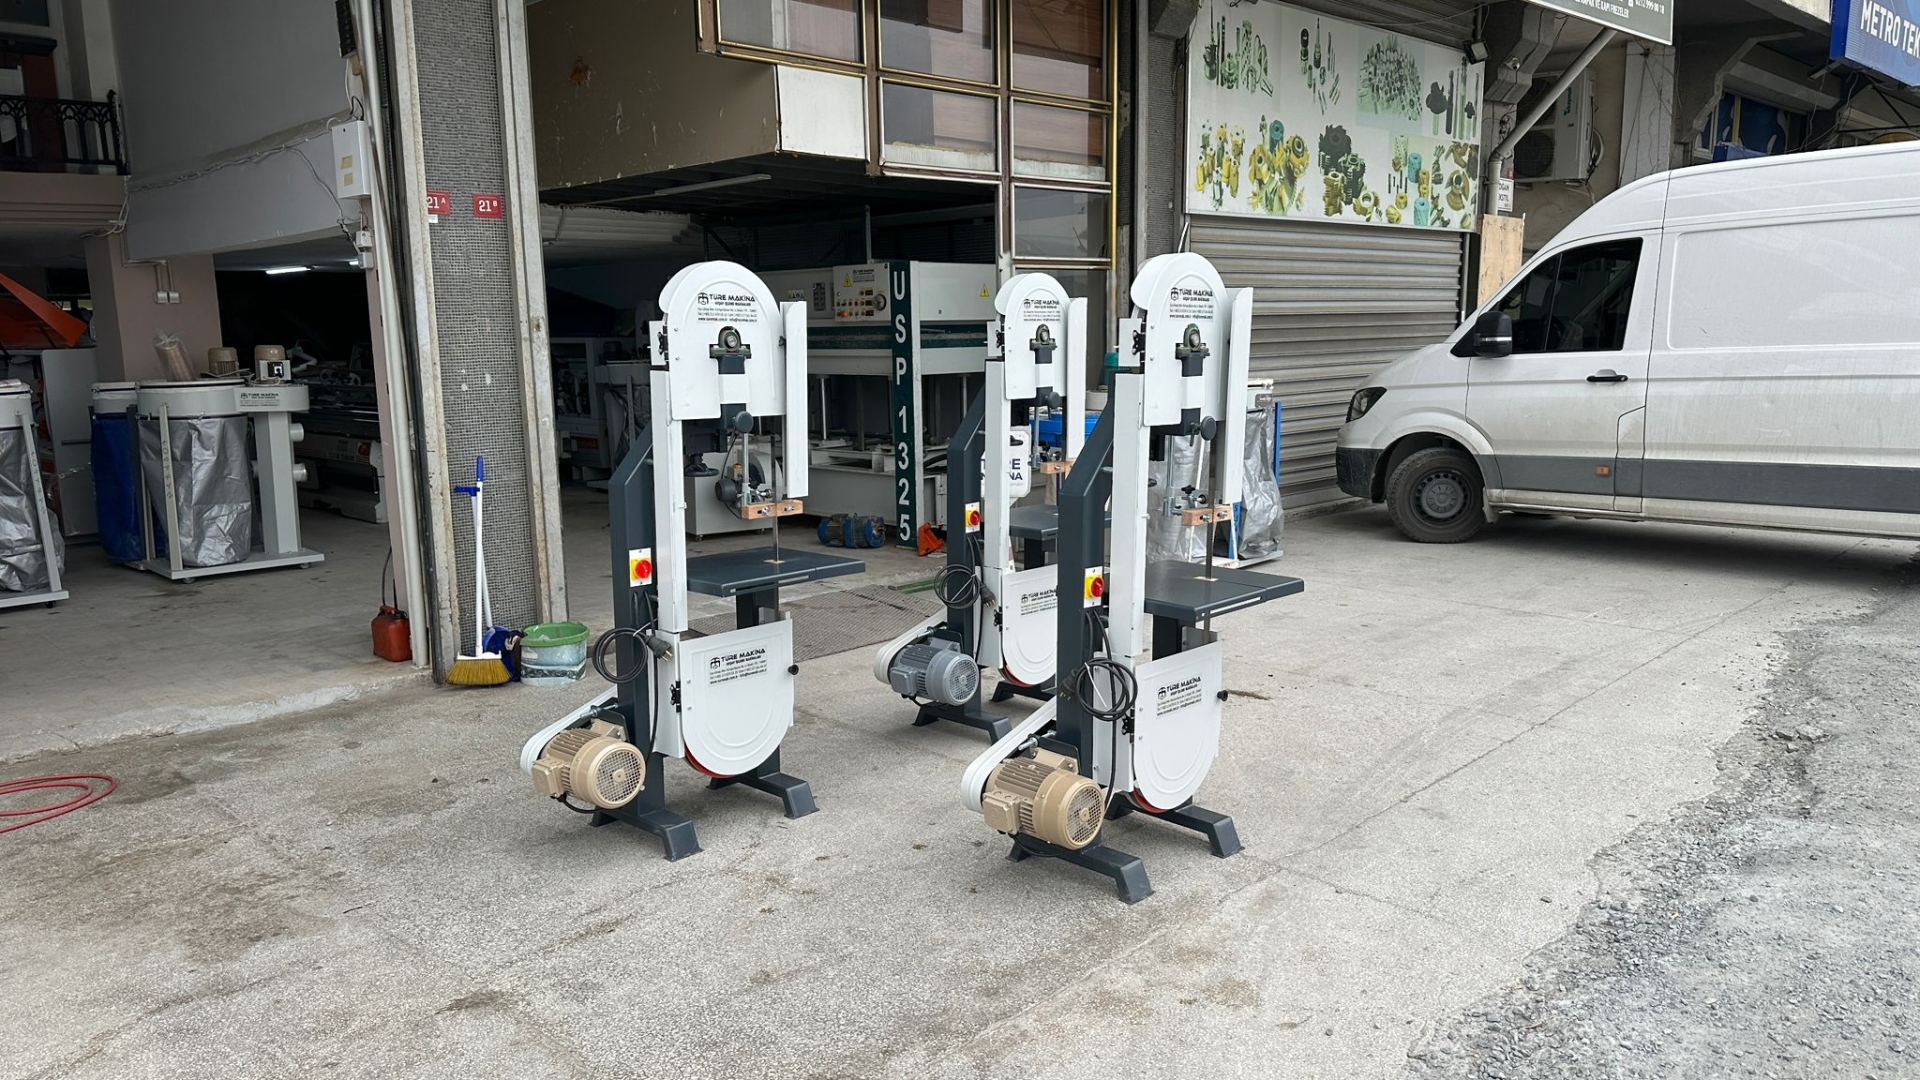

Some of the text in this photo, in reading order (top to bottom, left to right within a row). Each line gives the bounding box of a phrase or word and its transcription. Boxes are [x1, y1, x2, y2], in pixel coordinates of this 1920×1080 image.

[1861, 0, 1901, 47] METRO
[898, 406, 911, 541] 1325
[720, 648, 765, 662] TÜRE MAKİNA
[1180, 676, 1202, 688] MAKİNA
